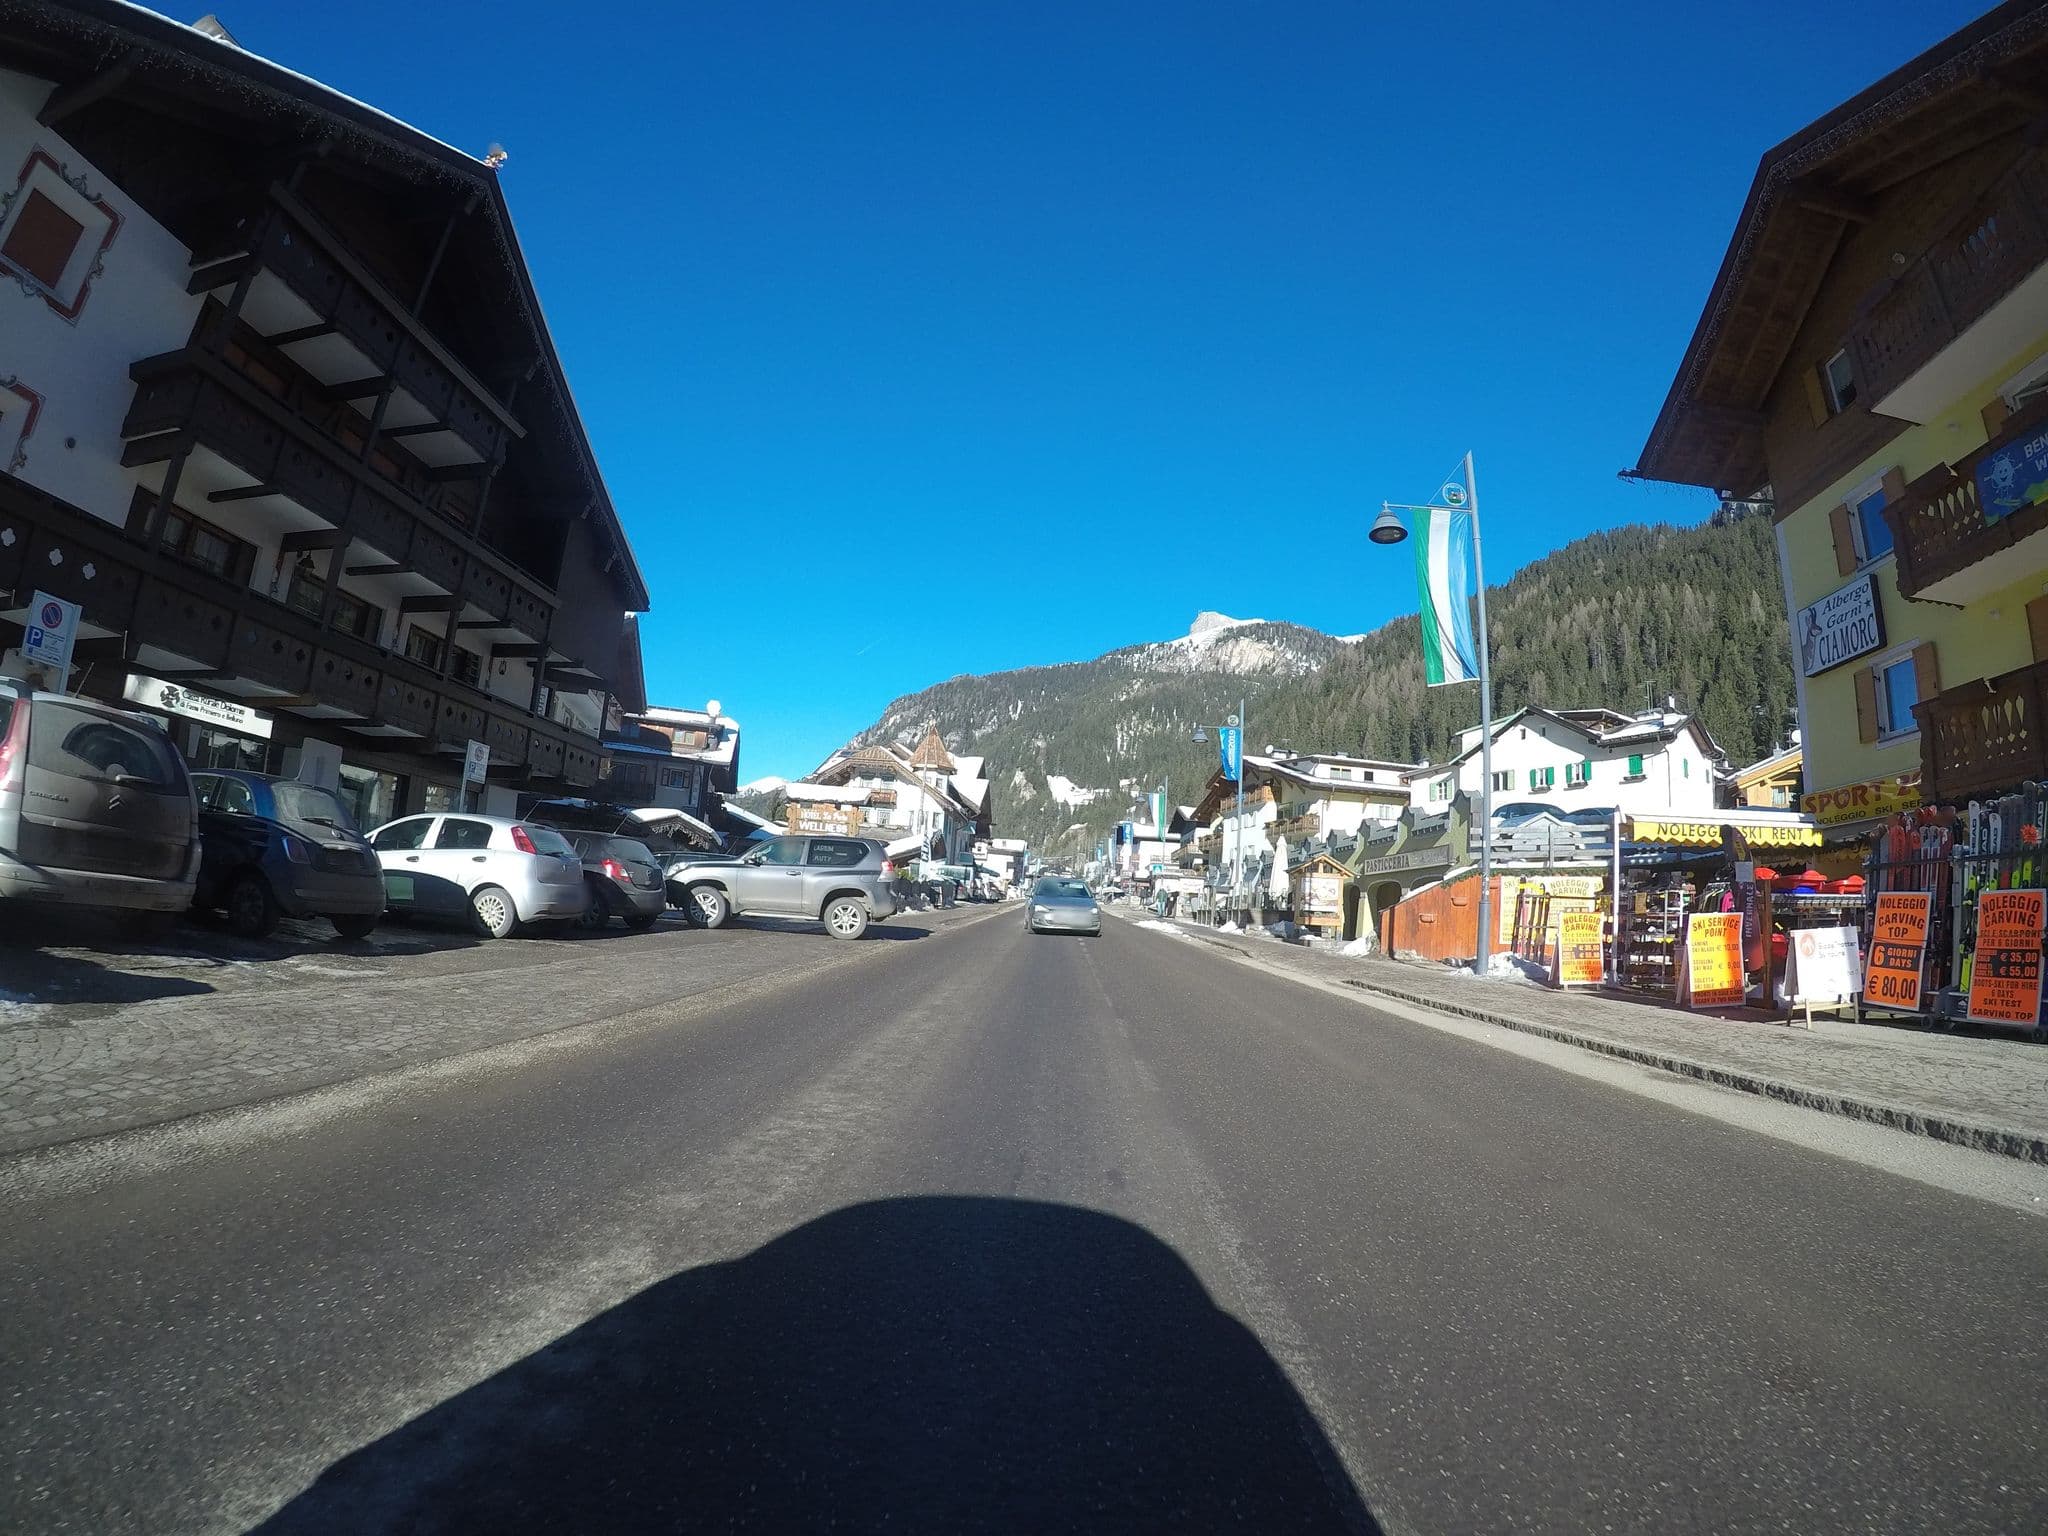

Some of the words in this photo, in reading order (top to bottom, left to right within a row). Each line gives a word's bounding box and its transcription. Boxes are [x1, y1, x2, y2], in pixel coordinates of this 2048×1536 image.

[1823, 583, 1869, 615] Albergo
[1819, 613, 1877, 666] CIAMORC
[1805, 780, 1886, 813] SPORT
[1817, 810, 1866, 824] NOLEGGIO
[1875, 804, 1893, 815] SKI
[800, 820, 848, 833] WELLNESS
[1741, 827, 1763, 839] SKI
[1772, 828, 1803, 840] RENT
[1366, 854, 1409, 873] PASTICCERIA
[1550, 879, 1589, 889] NOLEGGIO
[1553, 887, 1587, 896] CARVING
[1880, 898, 1926, 909] NOLEGGIO
[1982, 895, 2041, 915] NOLEGGIO
[1563, 914, 1601, 925] NOLEGGIO
[1692, 919, 1706, 932] SKI
[1708, 917, 1740, 931] SERVICE
[1878, 913, 1925, 930] CARVING
[1984, 911, 2036, 928] CARVING
[1565, 923, 1599, 932] CARVING
[1704, 927, 1727, 938] POINT
[1888, 927, 1908, 937] TOP
[2004, 938, 2034, 947] GIORNI
[1874, 945, 1885, 966] 6
[1887, 947, 1917, 958] GIORNI
[1889, 958, 1912, 968] DAYS
[1868, 975, 1879, 995] €
[1881, 976, 1916, 1003] 80,00
[1997, 989, 2015, 998] DAYS
[2000, 999, 2022, 1008] TEST
[1972, 1008, 2011, 1019] CARVING
[2015, 1011, 2033, 1020] TOP
